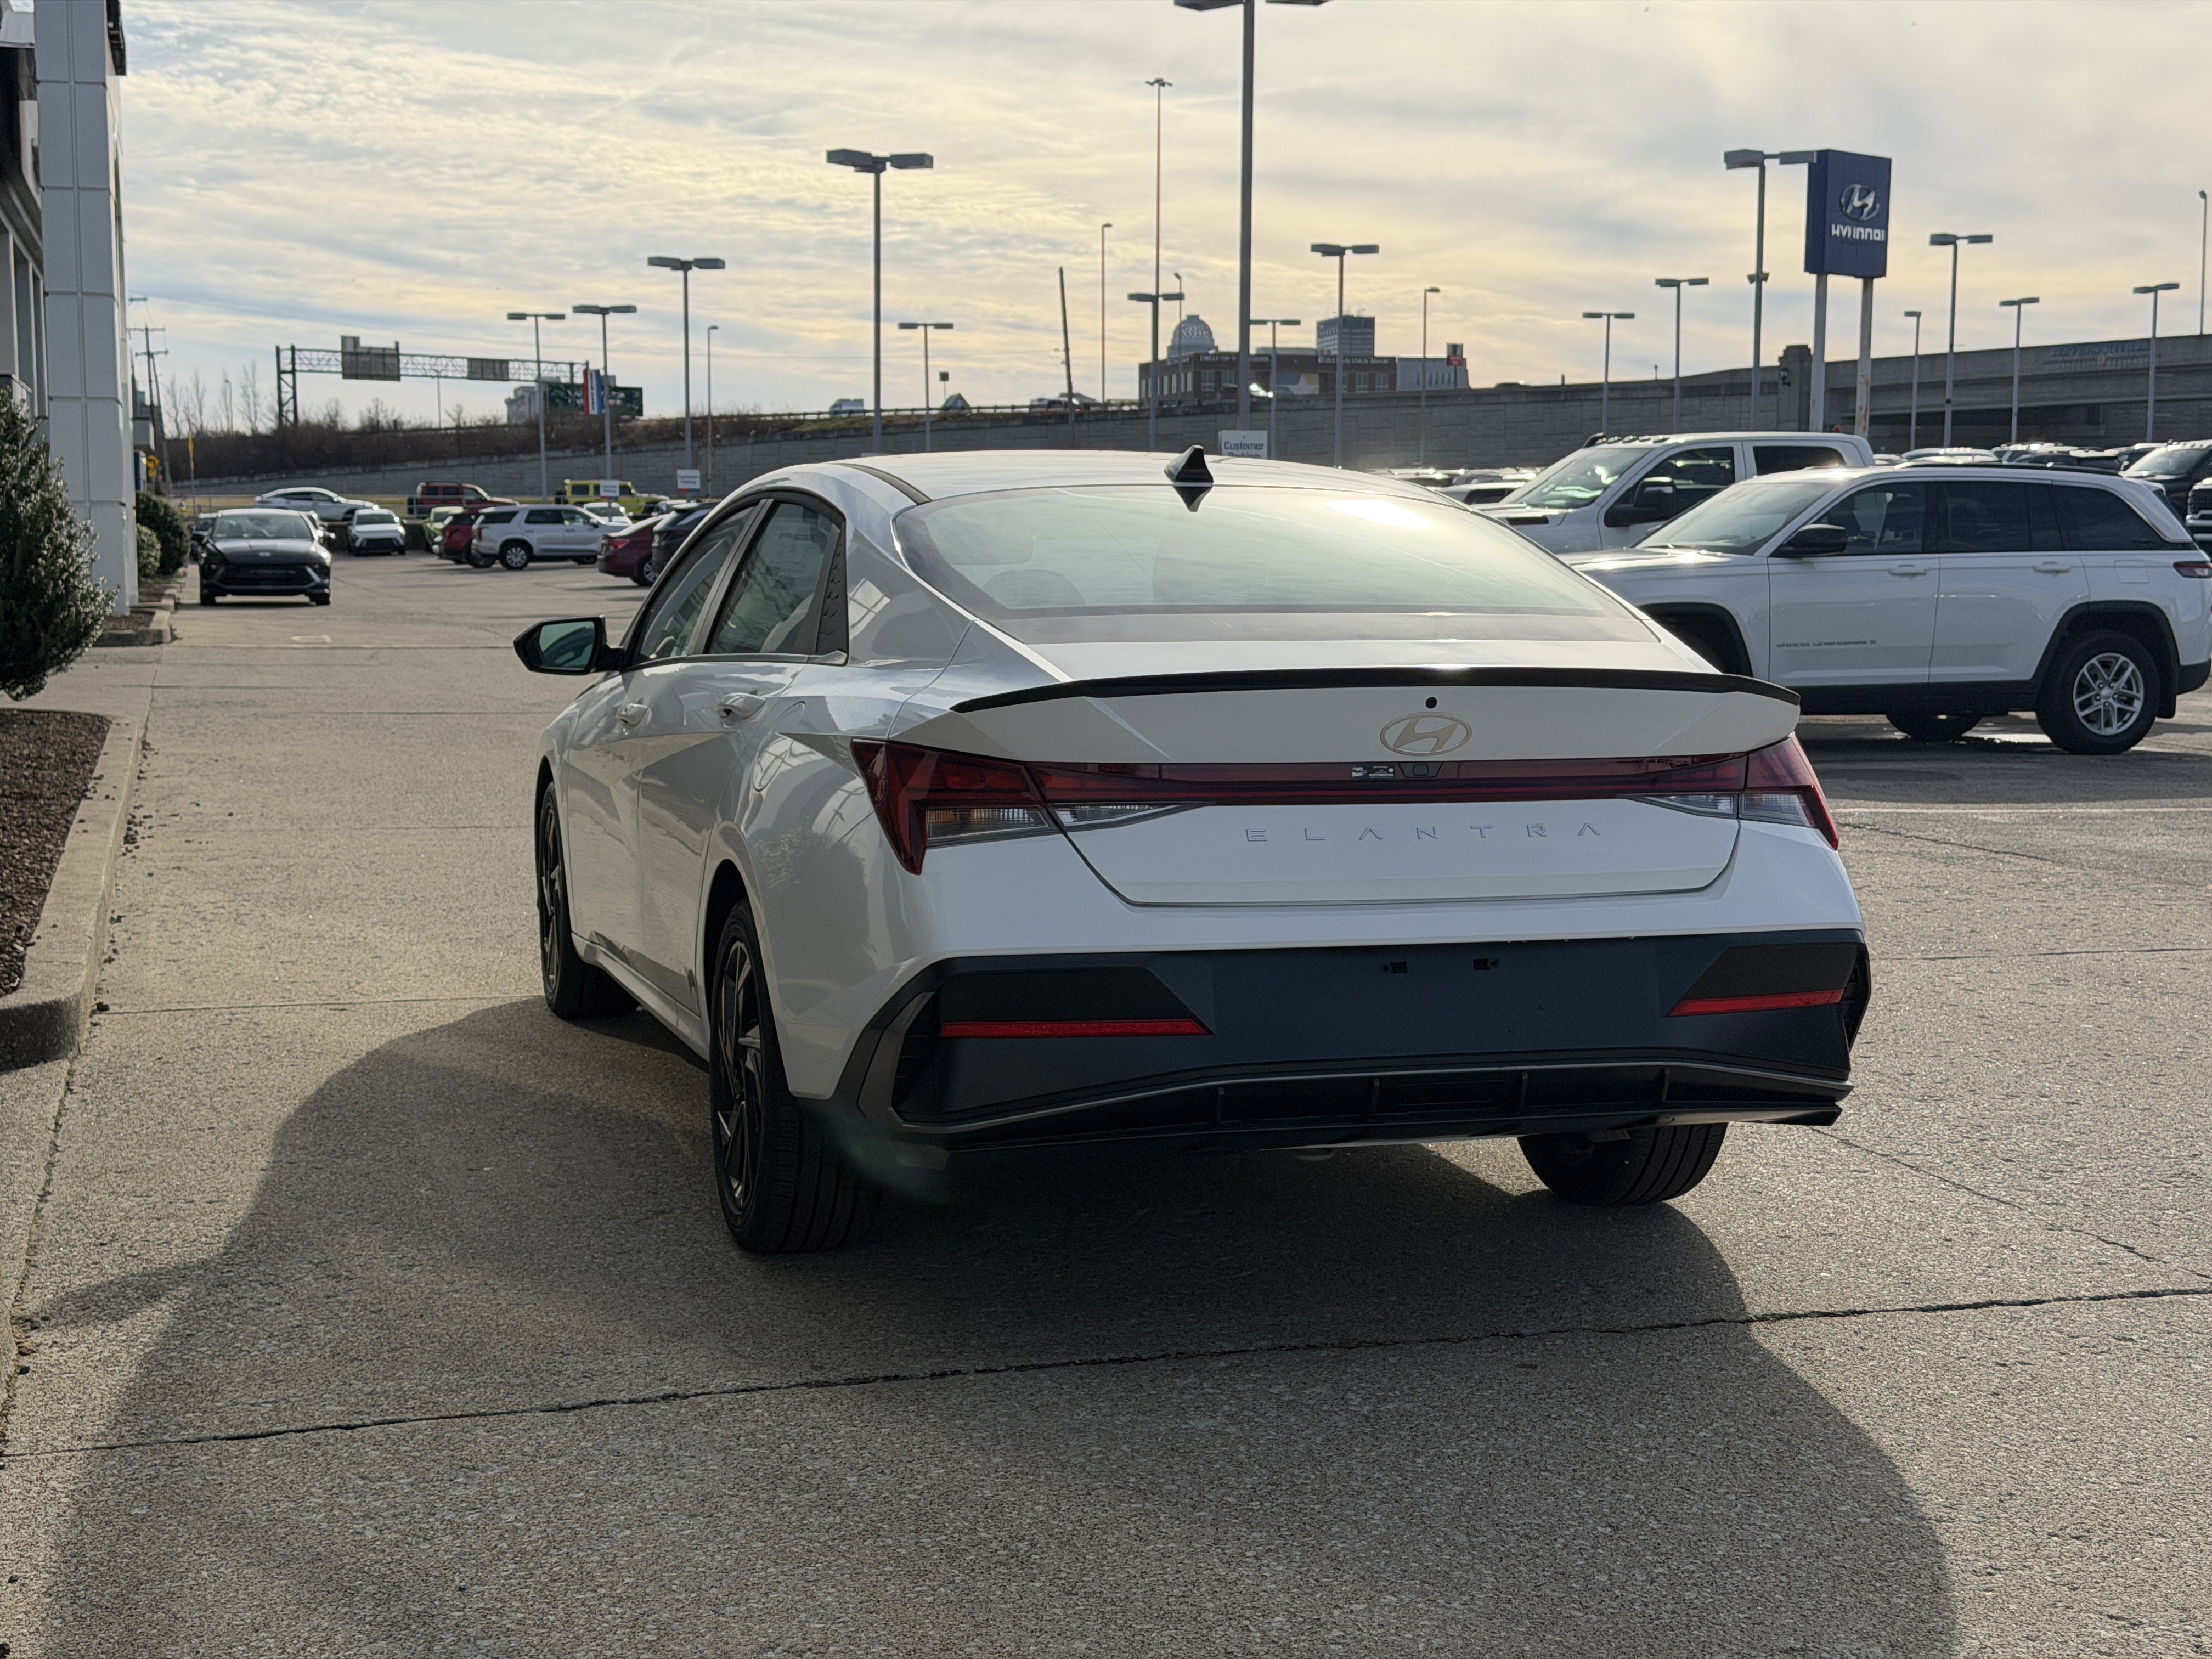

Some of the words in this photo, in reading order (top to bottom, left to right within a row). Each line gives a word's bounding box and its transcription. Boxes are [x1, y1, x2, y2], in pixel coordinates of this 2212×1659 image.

[1831, 223, 1884, 241] HYUNDAI
[1224, 441, 1264, 450] Customer
[1245, 822, 1601, 842] ELANTRA
